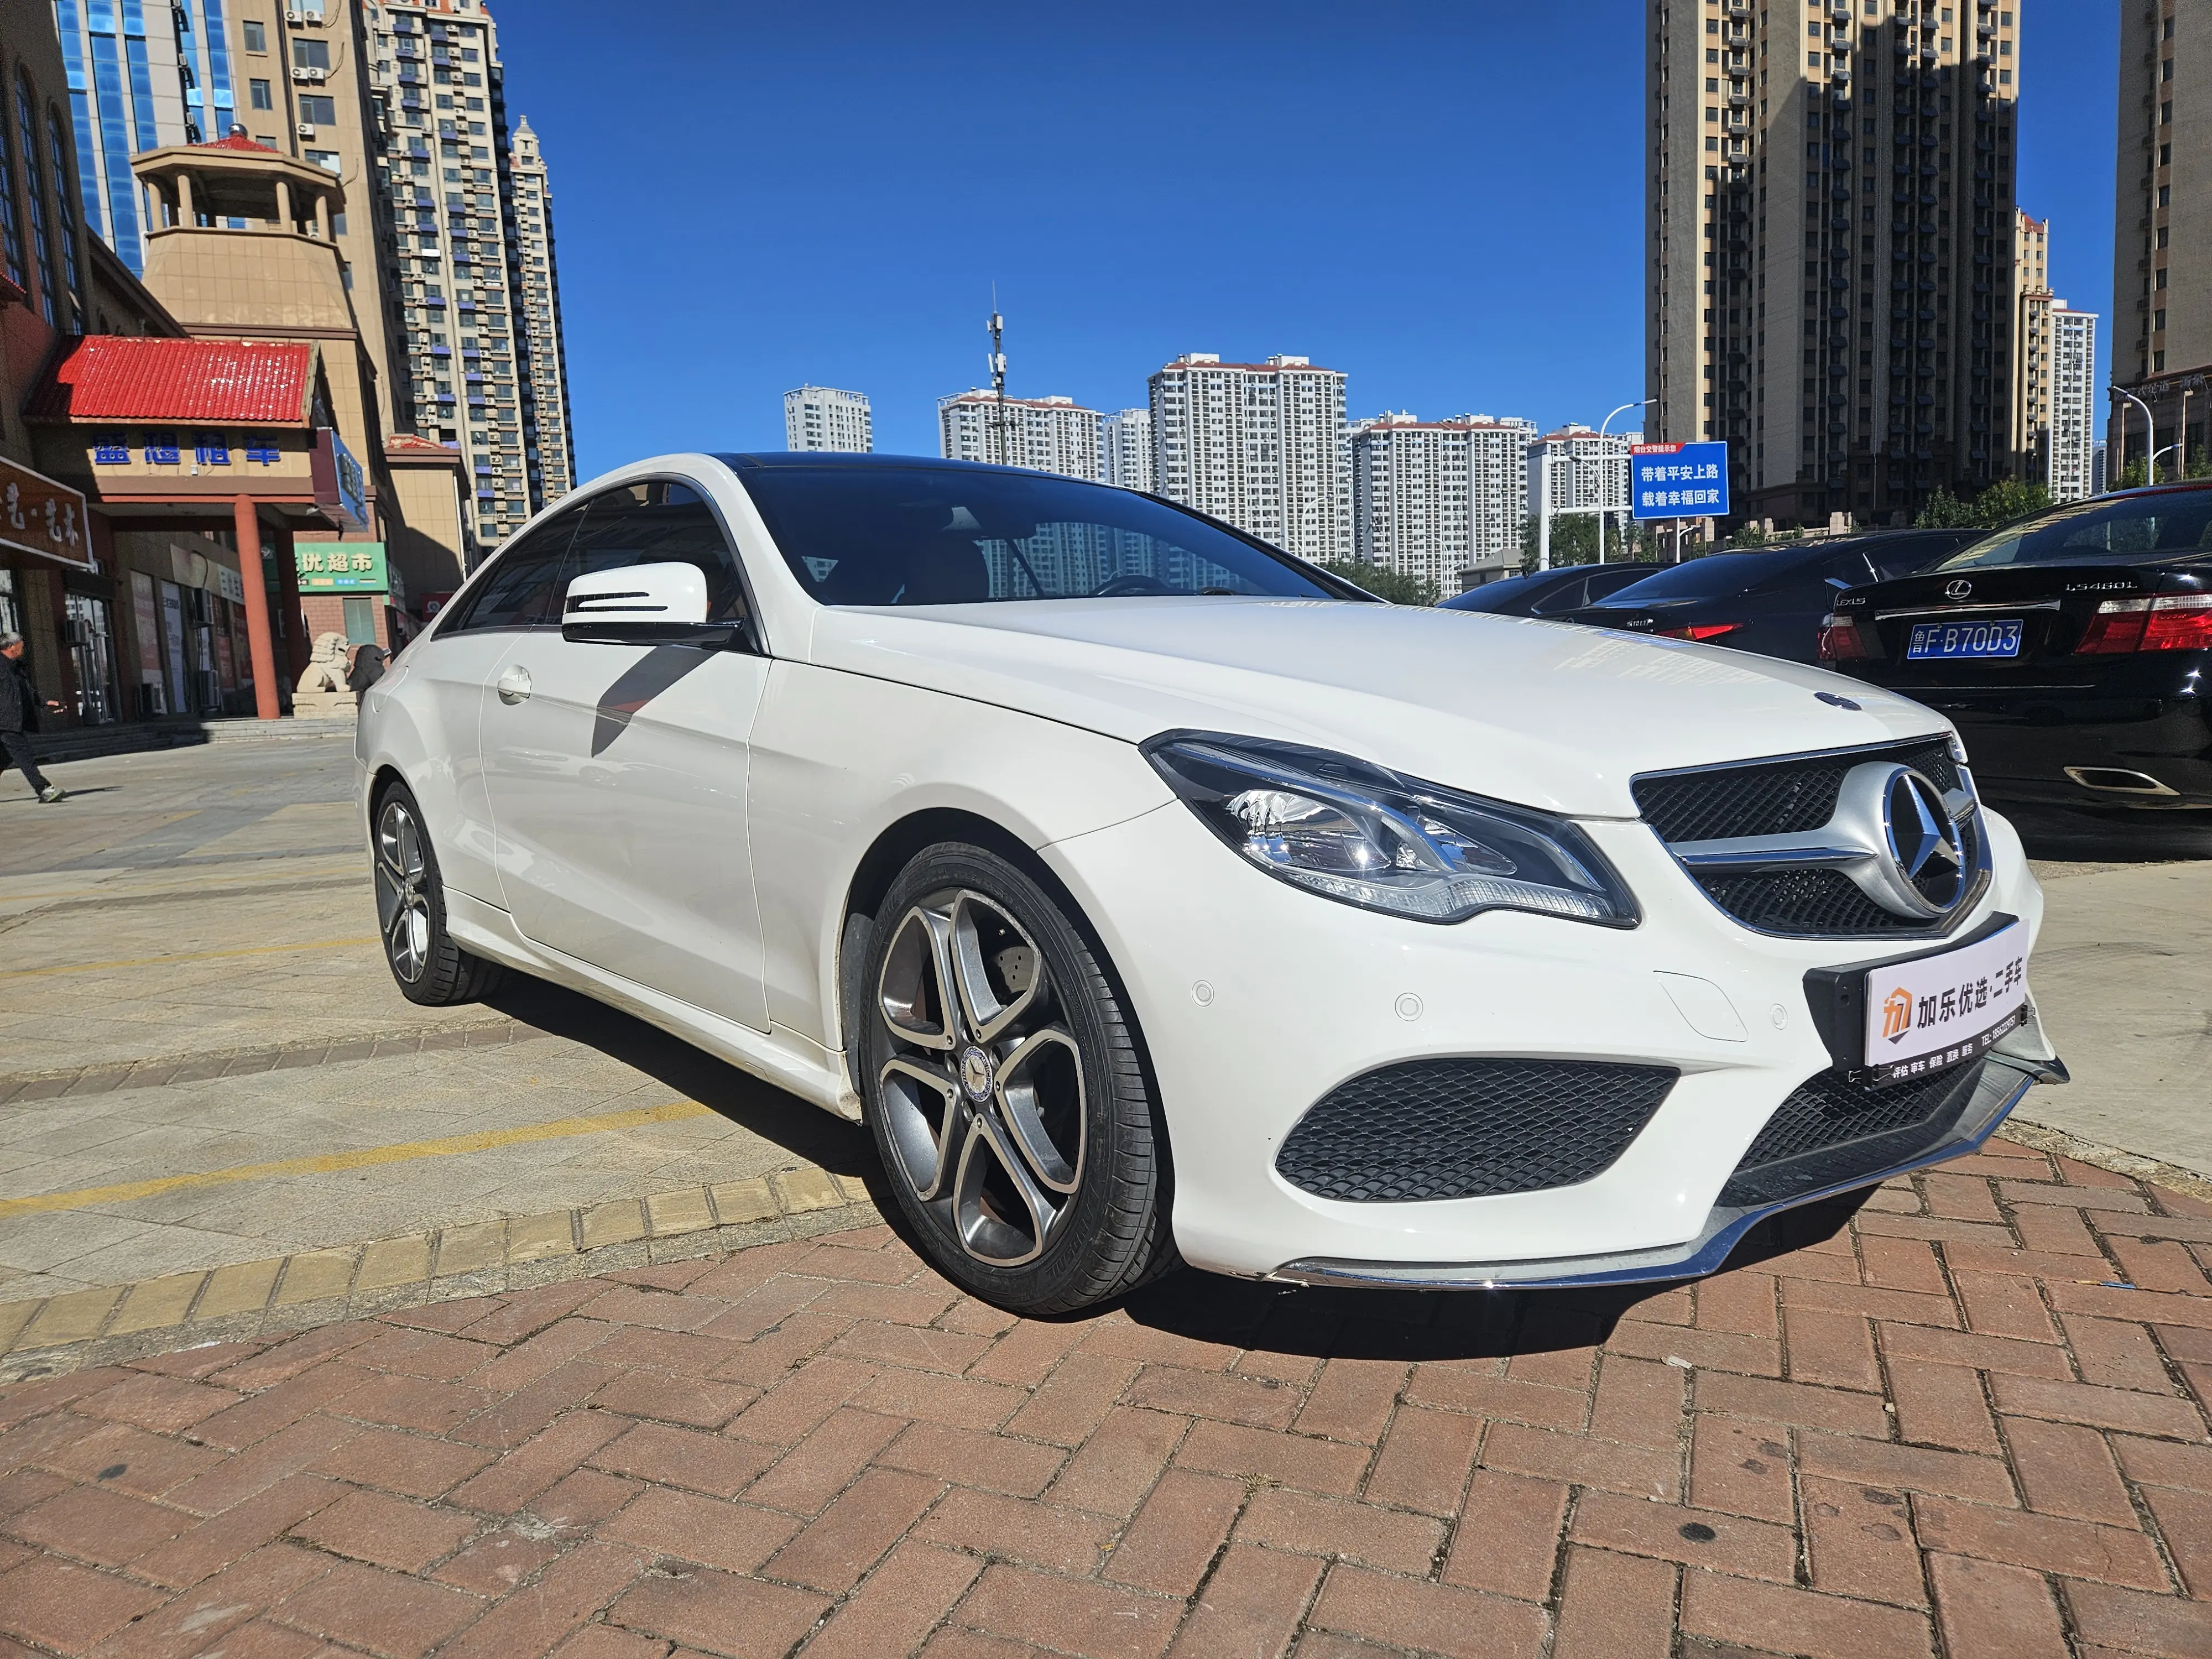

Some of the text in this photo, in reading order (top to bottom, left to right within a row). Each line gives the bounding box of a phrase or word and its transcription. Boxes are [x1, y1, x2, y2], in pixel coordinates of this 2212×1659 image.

[1634, 444, 1676, 453] 烟台交警提示您
[1641, 463, 1719, 482] 带着平安上路
[1642, 488, 1719, 507] 载着幸福回家
[295, 552, 372, 573] 优超市
[2065, 581, 2138, 591] LS460L
[1837, 598, 1866, 606] LEXUS
[1911, 1058, 1926, 1074] 审车
[1929, 1055, 1943, 1068] 保险
[1946, 1049, 1959, 1063] 置换
[1961, 1043, 1973, 1057] 服务
